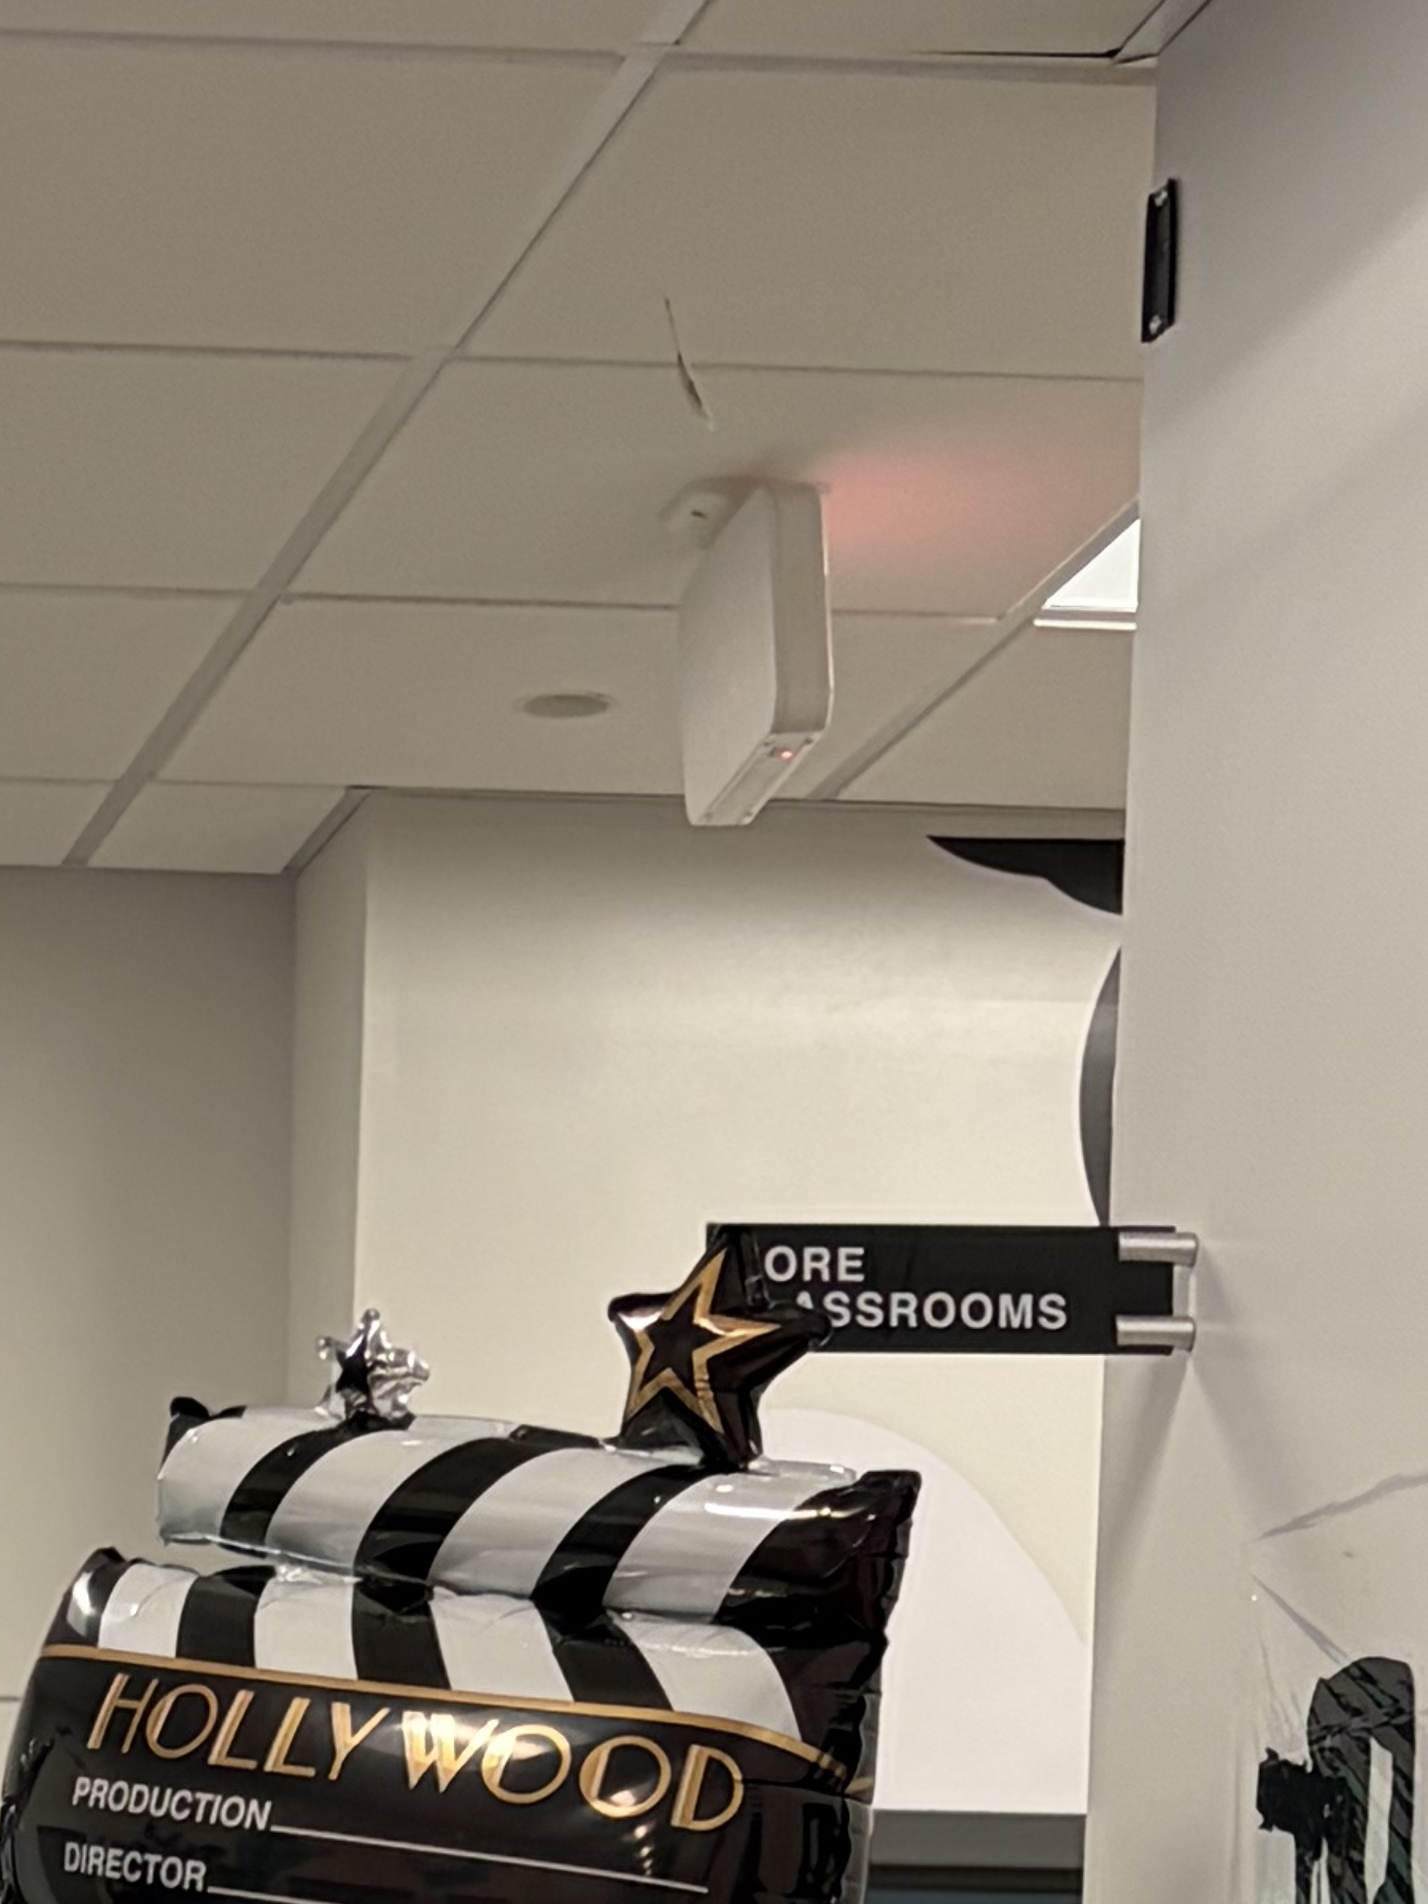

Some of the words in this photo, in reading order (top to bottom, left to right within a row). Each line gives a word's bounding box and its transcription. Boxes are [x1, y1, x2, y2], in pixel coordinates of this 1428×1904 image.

[763, 1244, 866, 1283] ORE
[86, 1672, 744, 1831] HOLLYWOOD
[72, 1776, 272, 1832] PRODUCTION
[63, 1842, 207, 1892] DIRECTOR
